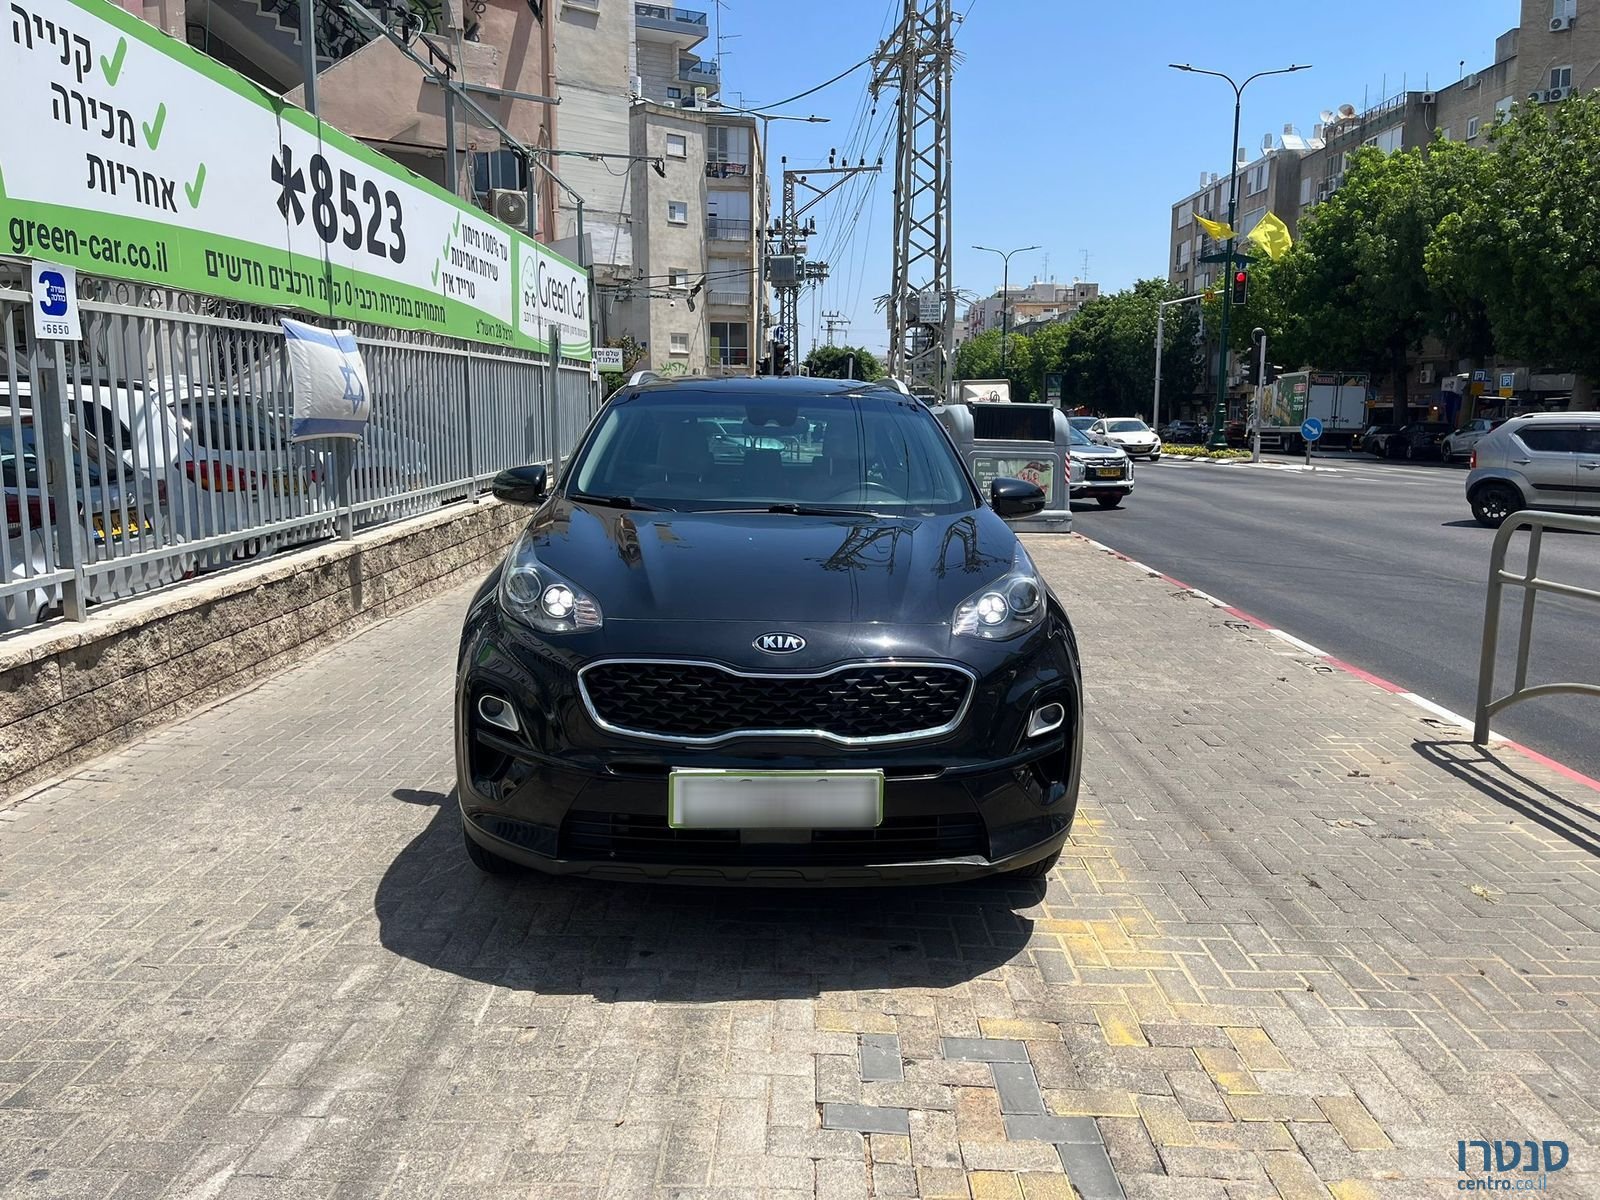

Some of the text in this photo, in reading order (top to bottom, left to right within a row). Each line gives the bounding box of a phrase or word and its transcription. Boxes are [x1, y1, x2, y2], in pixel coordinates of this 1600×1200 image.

[10, 2, 92, 83] קנייה
[50, 81, 136, 148] מכירה
[86, 152, 178, 213] אחריות
[9, 217, 168, 273] green-car.co.il
[461, 223, 508, 262] עד 100% מימון
[205, 249, 264, 288] חדשים
[268, 265, 314, 298] ורכבים
[451, 246, 499, 282] שירות ואמינות
[344, 280, 352, 306] 0
[355, 288, 378, 311] רכבי
[442, 272, 475, 299] טרייד אין
[538, 261, 586, 320] Green Car
[380, 292, 413, 317] במכירת
[414, 298, 446, 324] מתמחים
[763, 635, 800, 649] KIA
